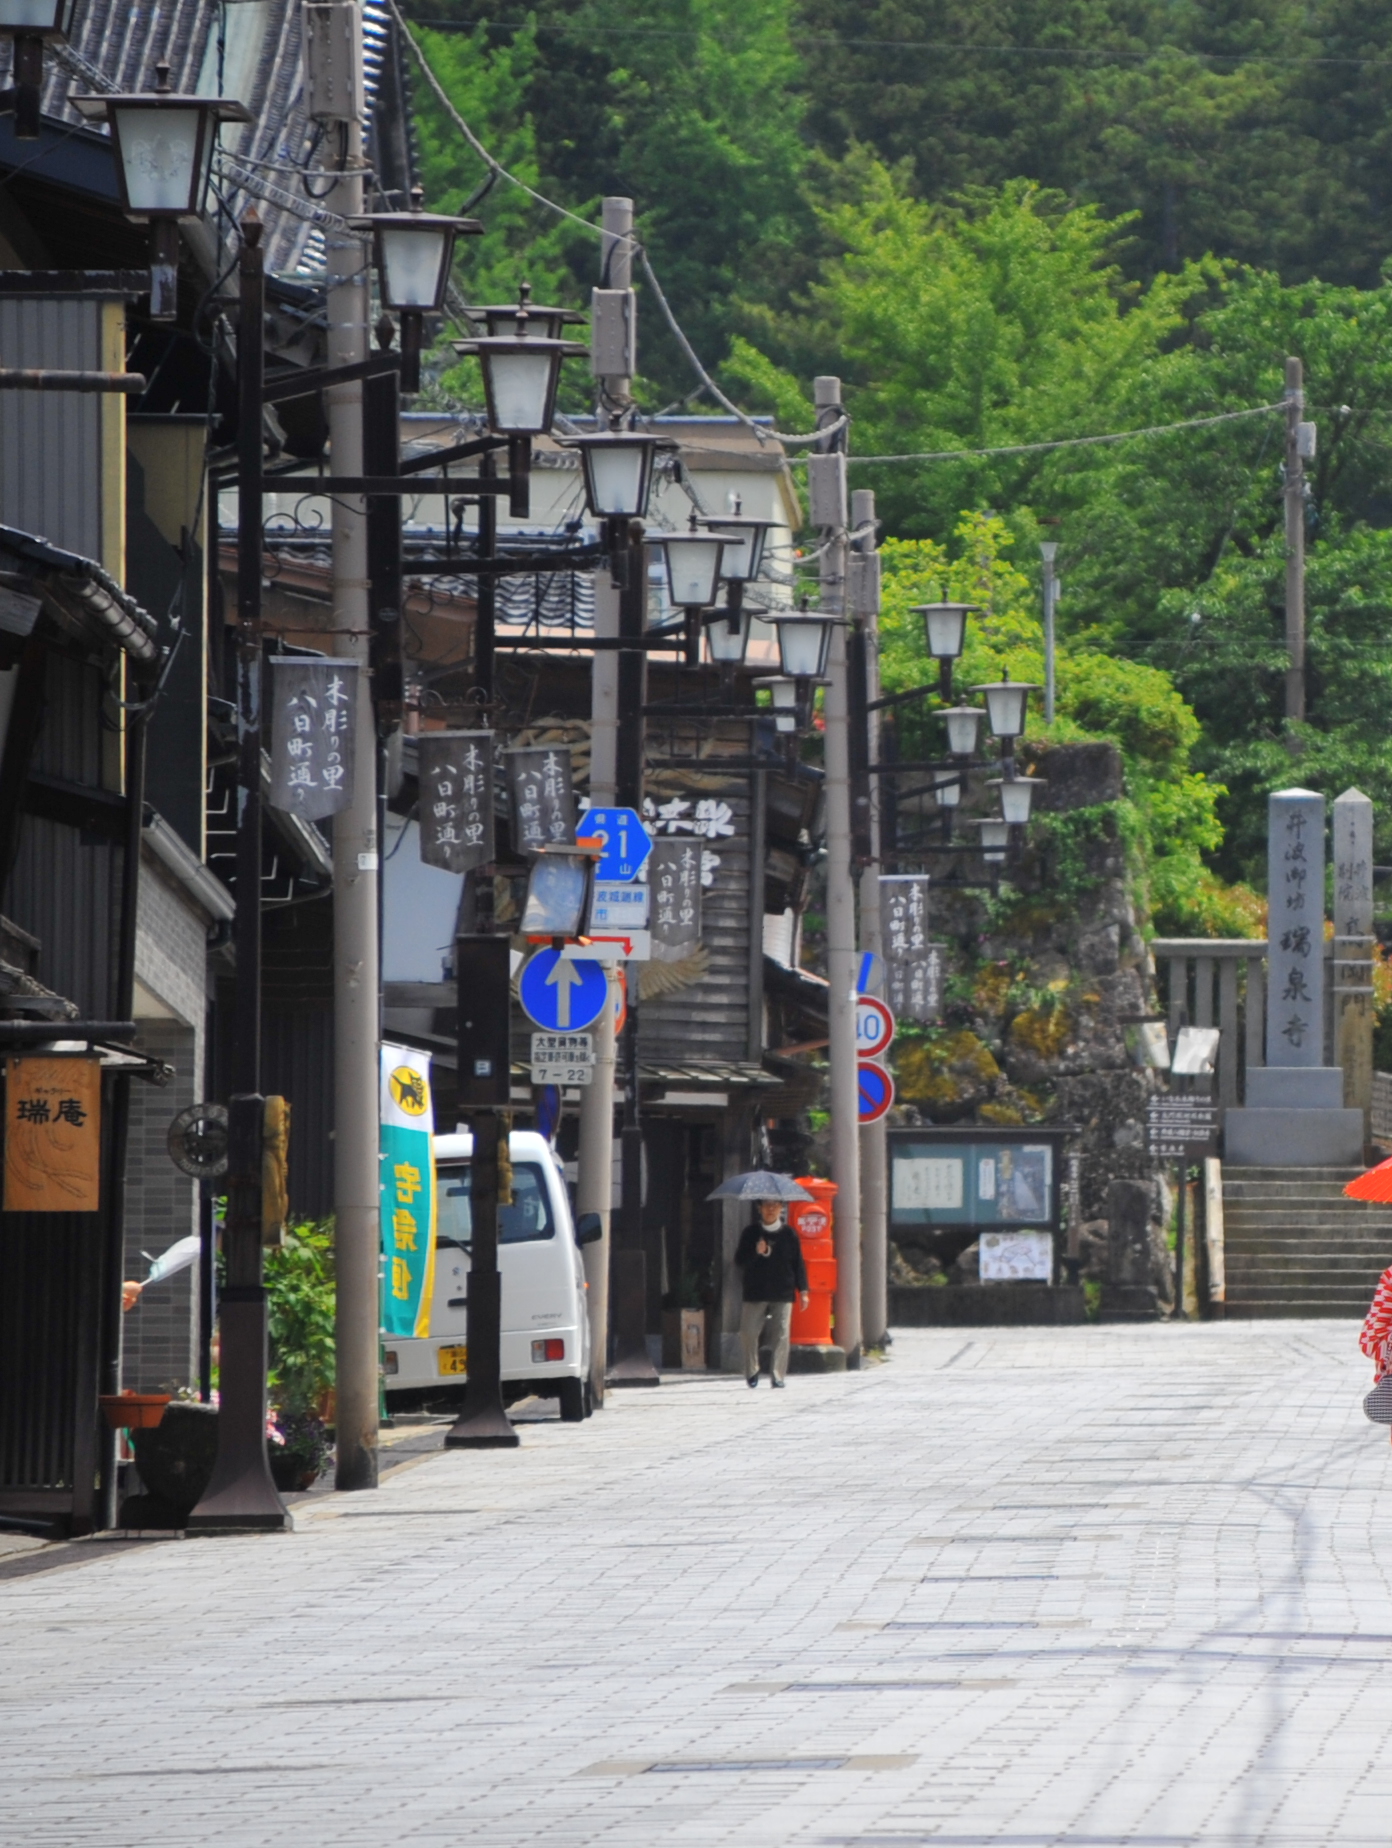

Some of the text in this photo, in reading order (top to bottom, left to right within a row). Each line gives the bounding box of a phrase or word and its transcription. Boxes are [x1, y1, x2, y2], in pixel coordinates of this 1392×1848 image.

[287, 695, 318, 800] 八日町通り
[322, 674, 349, 790] 木彫りの里
[431, 764, 462, 858] 八日町通り
[463, 743, 485, 846] 木彫りの里
[543, 751, 567, 842] 木彫りの里
[656, 861, 678, 934] 八日町通り
[679, 847, 697, 926] 木彫りの里
[888, 896, 910, 957] 八日町通り
[909, 882, 924, 950] 木彫りの里
[16, 1098, 88, 1127] 瑞庵
